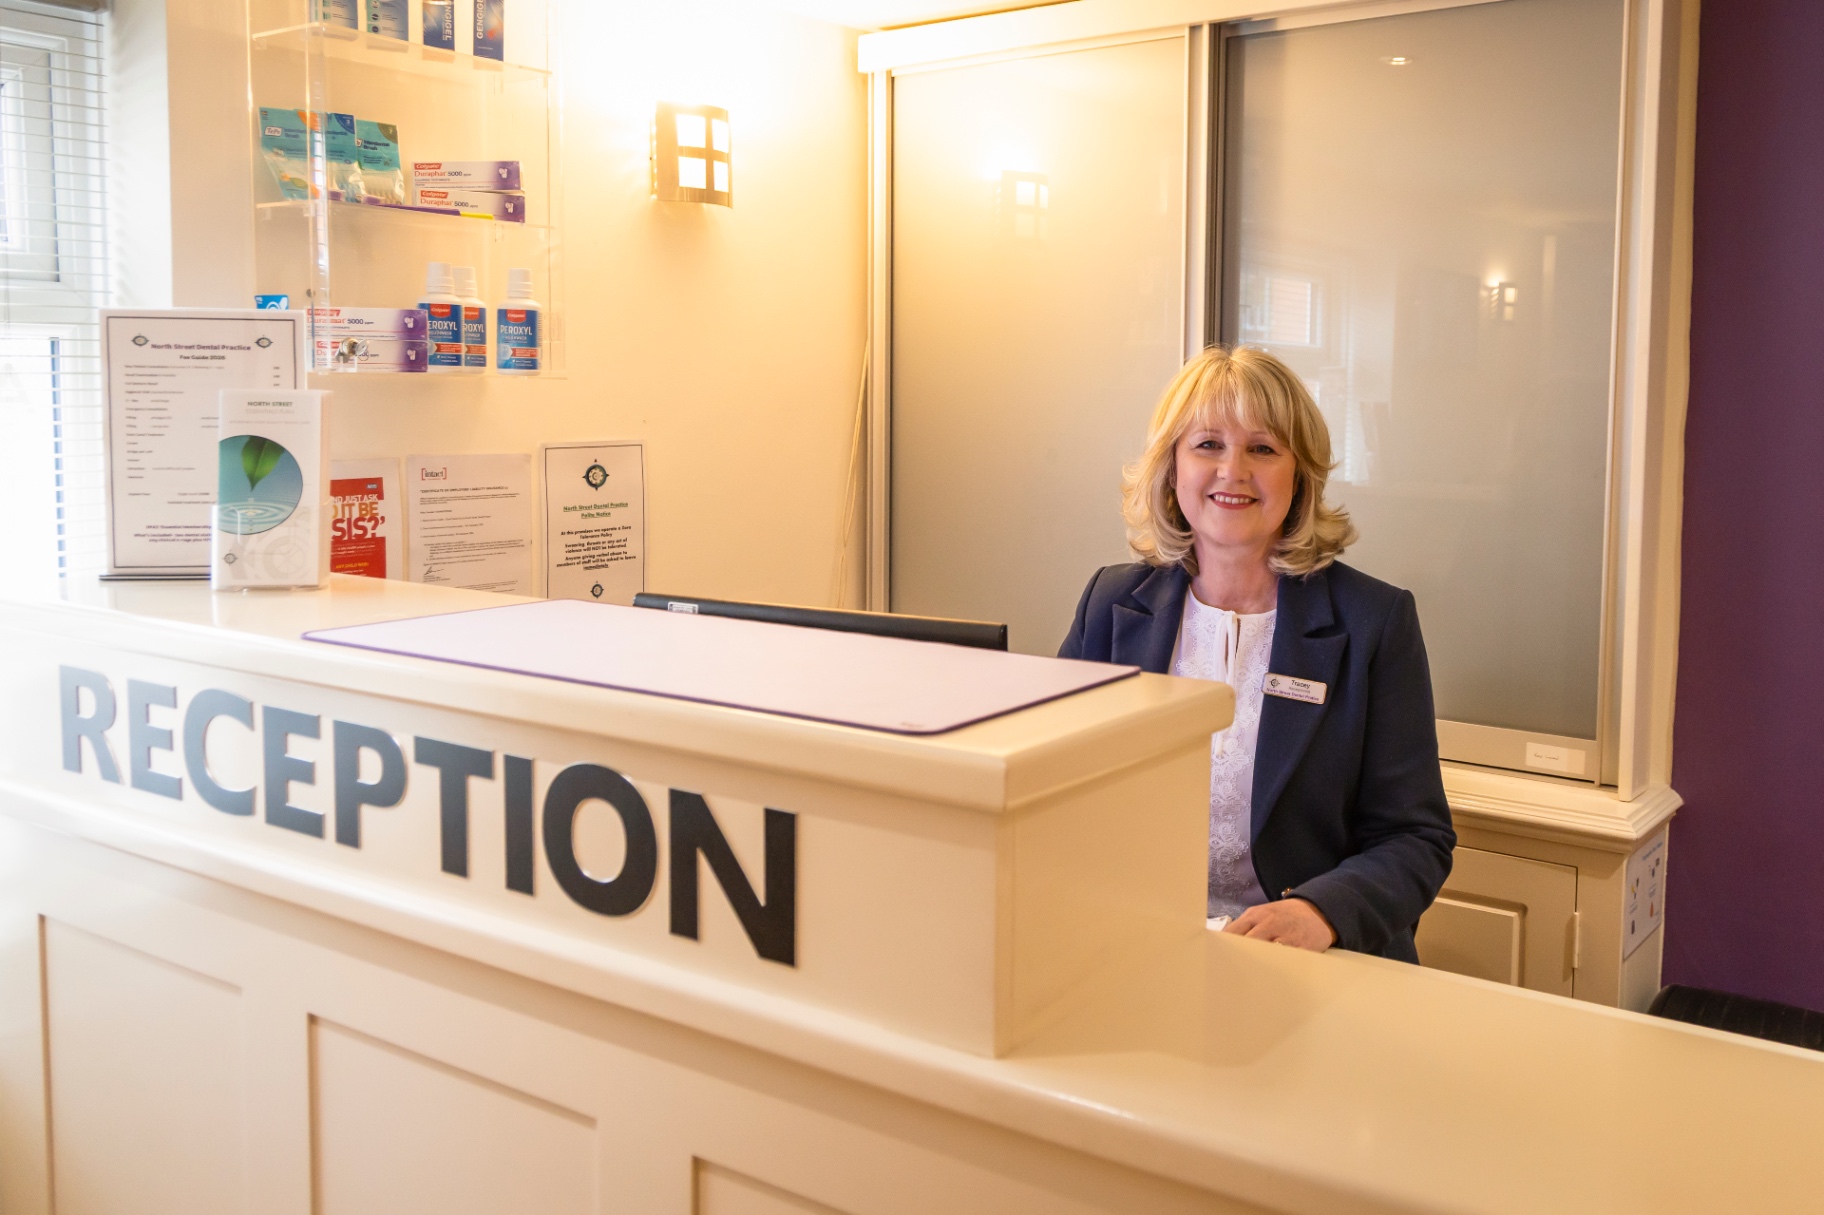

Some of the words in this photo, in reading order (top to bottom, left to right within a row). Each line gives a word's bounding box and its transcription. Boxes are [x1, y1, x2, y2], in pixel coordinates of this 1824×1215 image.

[428, 321, 457, 330] EROXYL
[463, 324, 484, 332] ROXYL
[500, 325, 532, 335] PEROXYL
[341, 503, 355, 518] IT
[359, 502, 379, 517] BE
[1291, 680, 1310, 689] Tracey
[58, 664, 797, 967] RECEPTION
